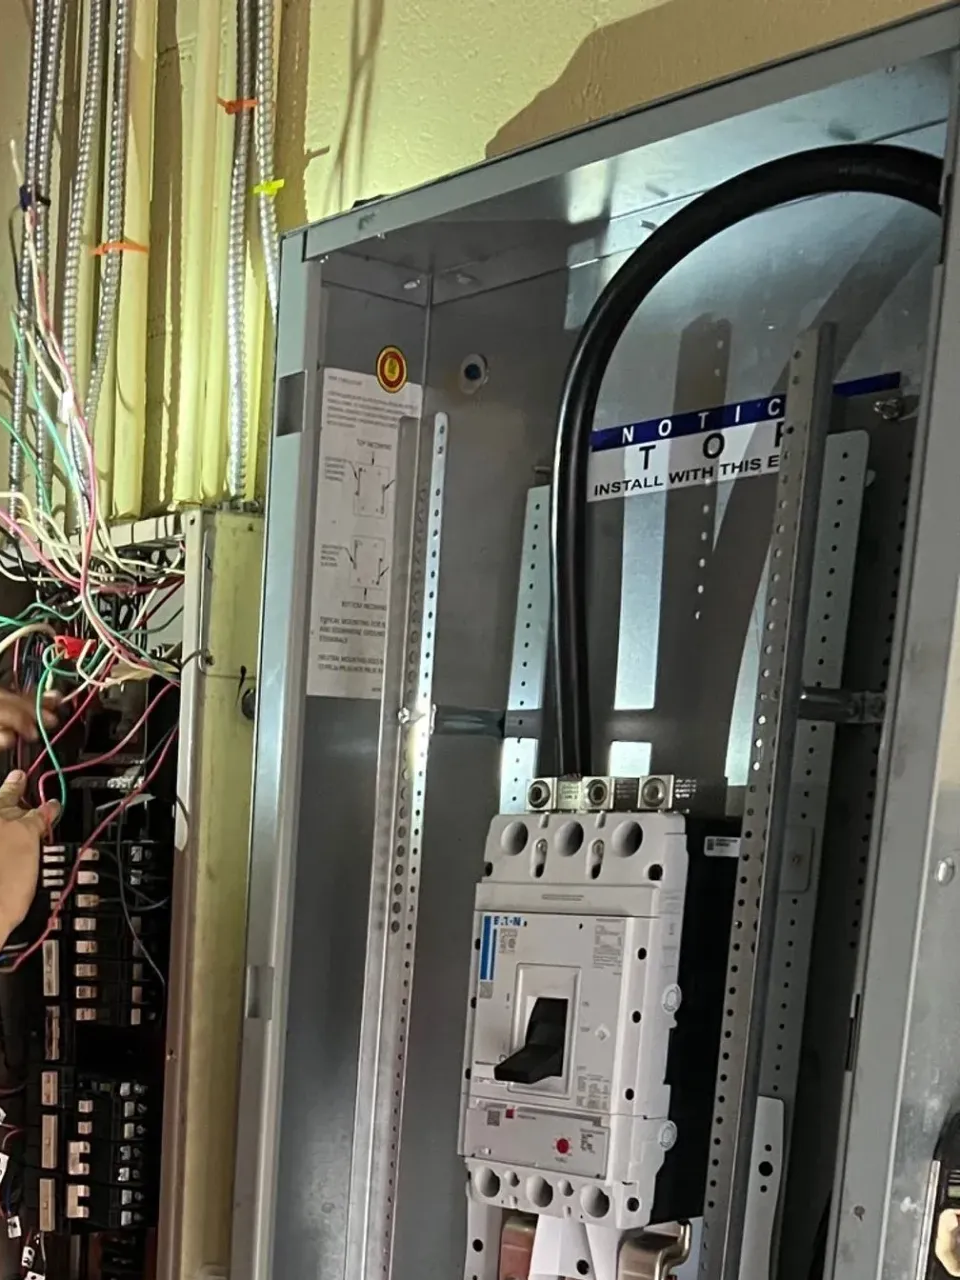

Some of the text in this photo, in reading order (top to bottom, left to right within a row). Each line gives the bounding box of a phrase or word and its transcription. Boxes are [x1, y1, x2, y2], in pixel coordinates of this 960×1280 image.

[621, 397, 781, 443] NOTIC
[593, 454, 780, 497] INSTALL WITH THIS E
